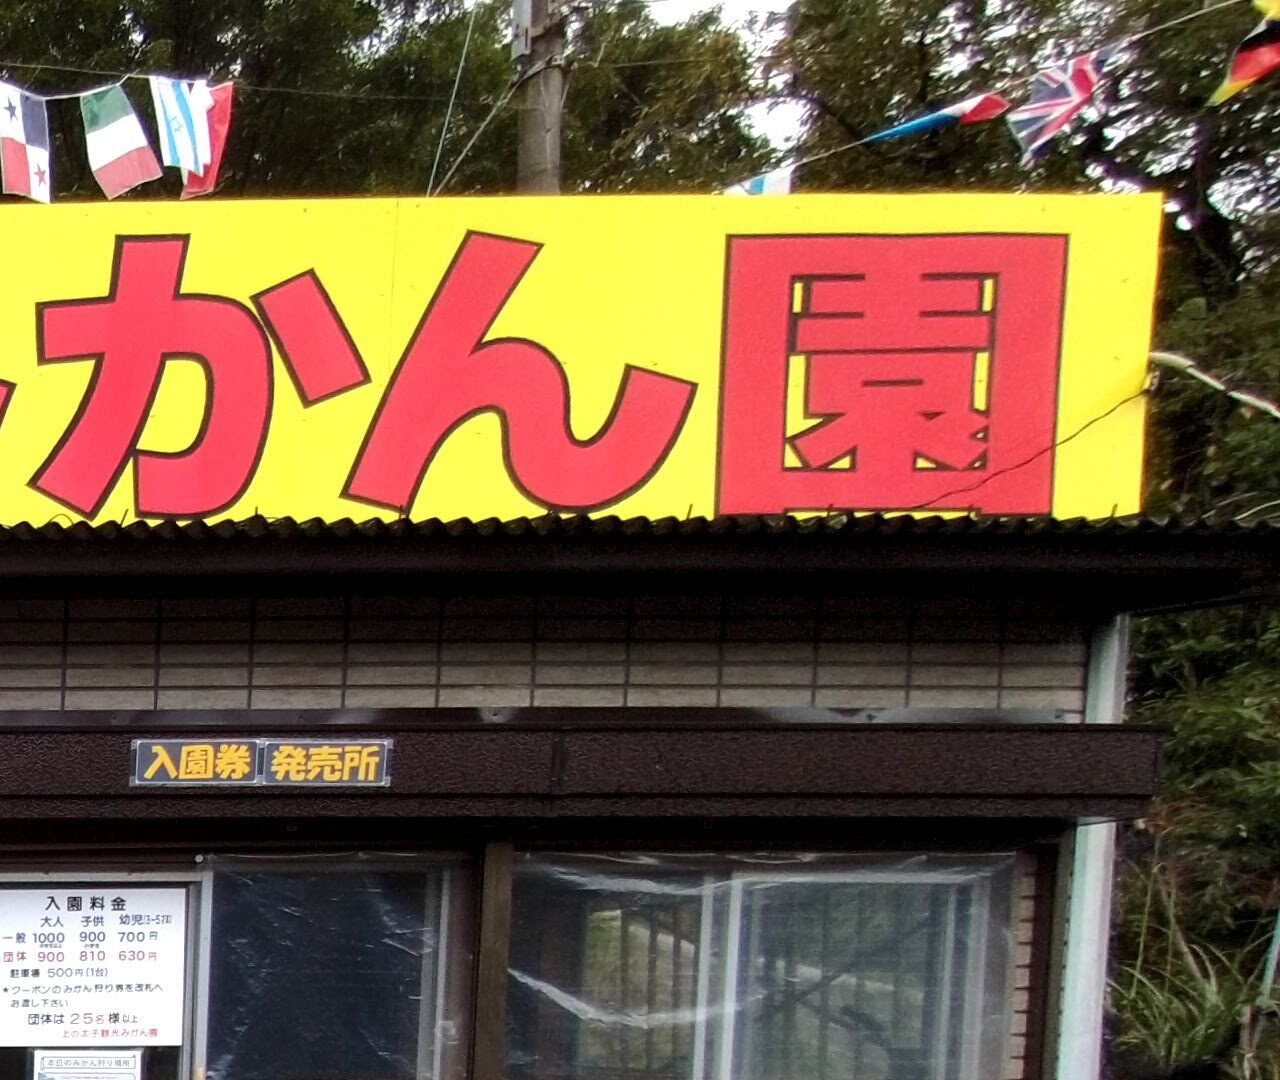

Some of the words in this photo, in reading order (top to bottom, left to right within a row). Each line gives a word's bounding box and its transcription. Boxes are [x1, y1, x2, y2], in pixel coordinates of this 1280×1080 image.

[142, 743, 251, 781] 入園券
[270, 744, 381, 782] 発売所
[44, 896, 127, 912] 入園料金
[40, 916, 64, 928] 大人
[80, 916, 105, 928] 子供
[2, 932, 27, 943] 一般
[32, 932, 65, 944] 1000
[79, 931, 106, 942] 900
[117, 931, 145, 942] 700
[3, 951, 27, 963] 団体
[37, 951, 65, 963] 900
[79, 950, 106, 962] 810
[118, 950, 145, 961] 630
